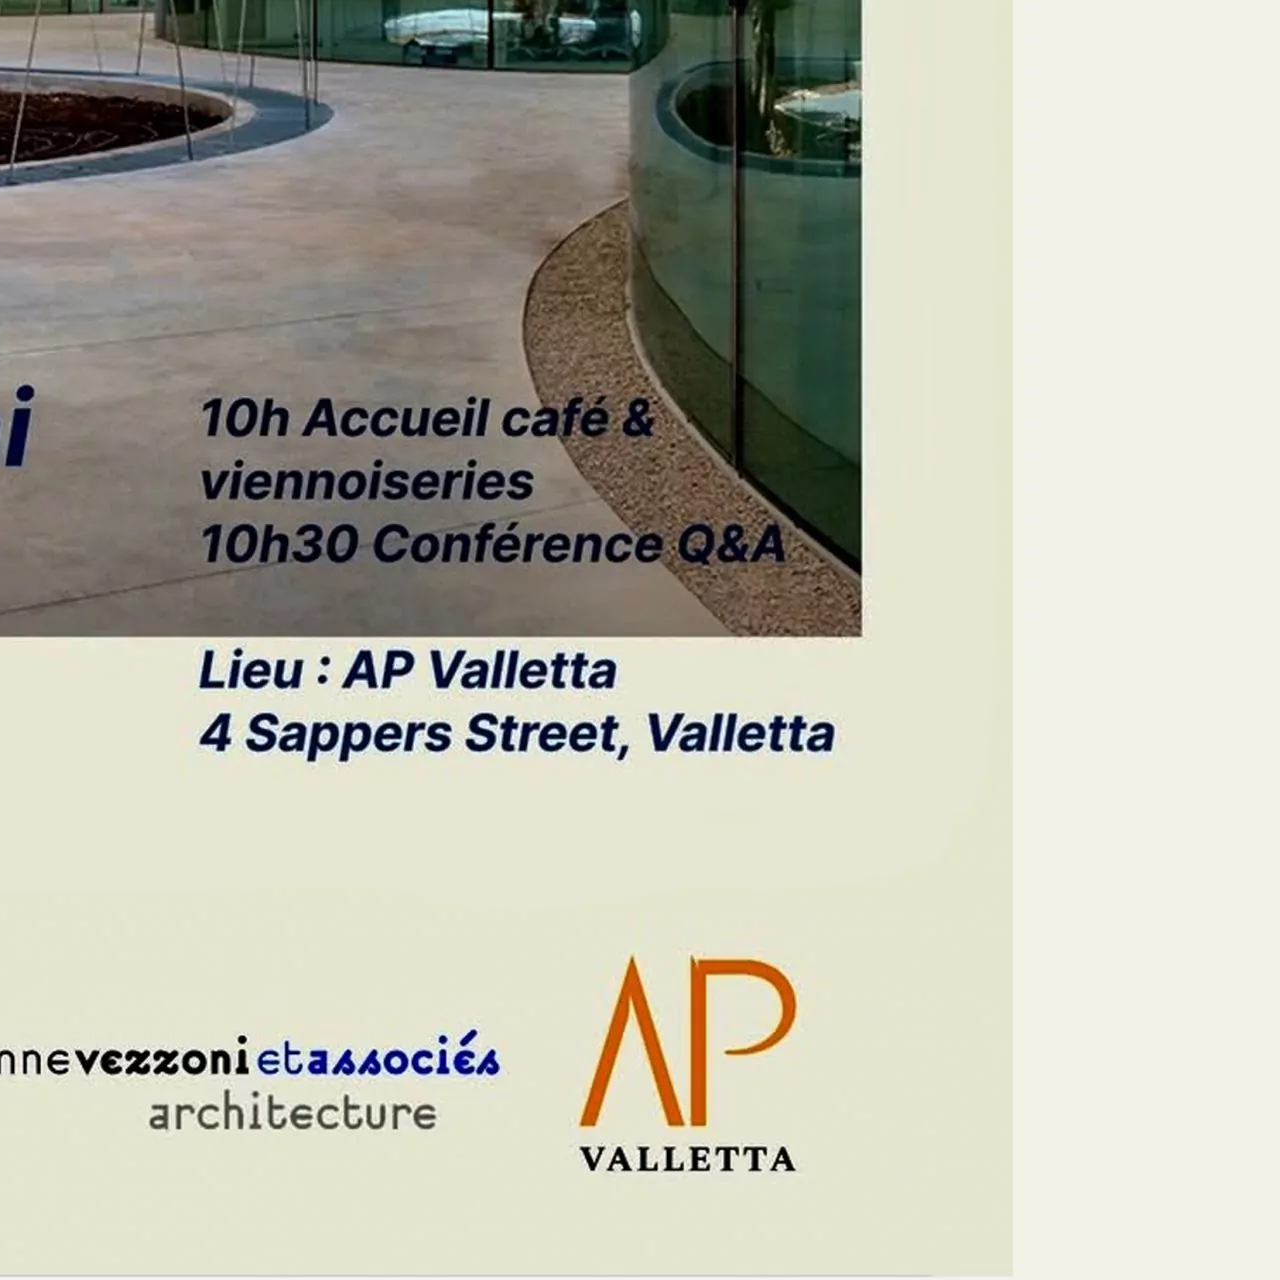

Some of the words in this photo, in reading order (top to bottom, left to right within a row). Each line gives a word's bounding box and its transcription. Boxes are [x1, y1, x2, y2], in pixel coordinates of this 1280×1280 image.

[203, 398, 289, 437] 10h
[303, 397, 490, 437] Accueil
[502, 397, 608, 437] café
[623, 398, 654, 437] &
[202, 461, 533, 500] viennoiseries
[203, 524, 358, 563] 10h30
[374, 523, 662, 563] Conférence
[678, 524, 785, 564] Q&A
[199, 648, 304, 689] Lieu
[342, 650, 415, 689] AP
[430, 650, 616, 689] Valletta
[200, 713, 231, 751] 4
[246, 713, 452, 762] Sappers
[466, 713, 628, 761] Street,
[649, 713, 834, 752] Valletta
[580, 956, 796, 1126] AP
[150, 1090, 436, 1129] architecture
[580, 1146, 796, 1171] VALLETTA
